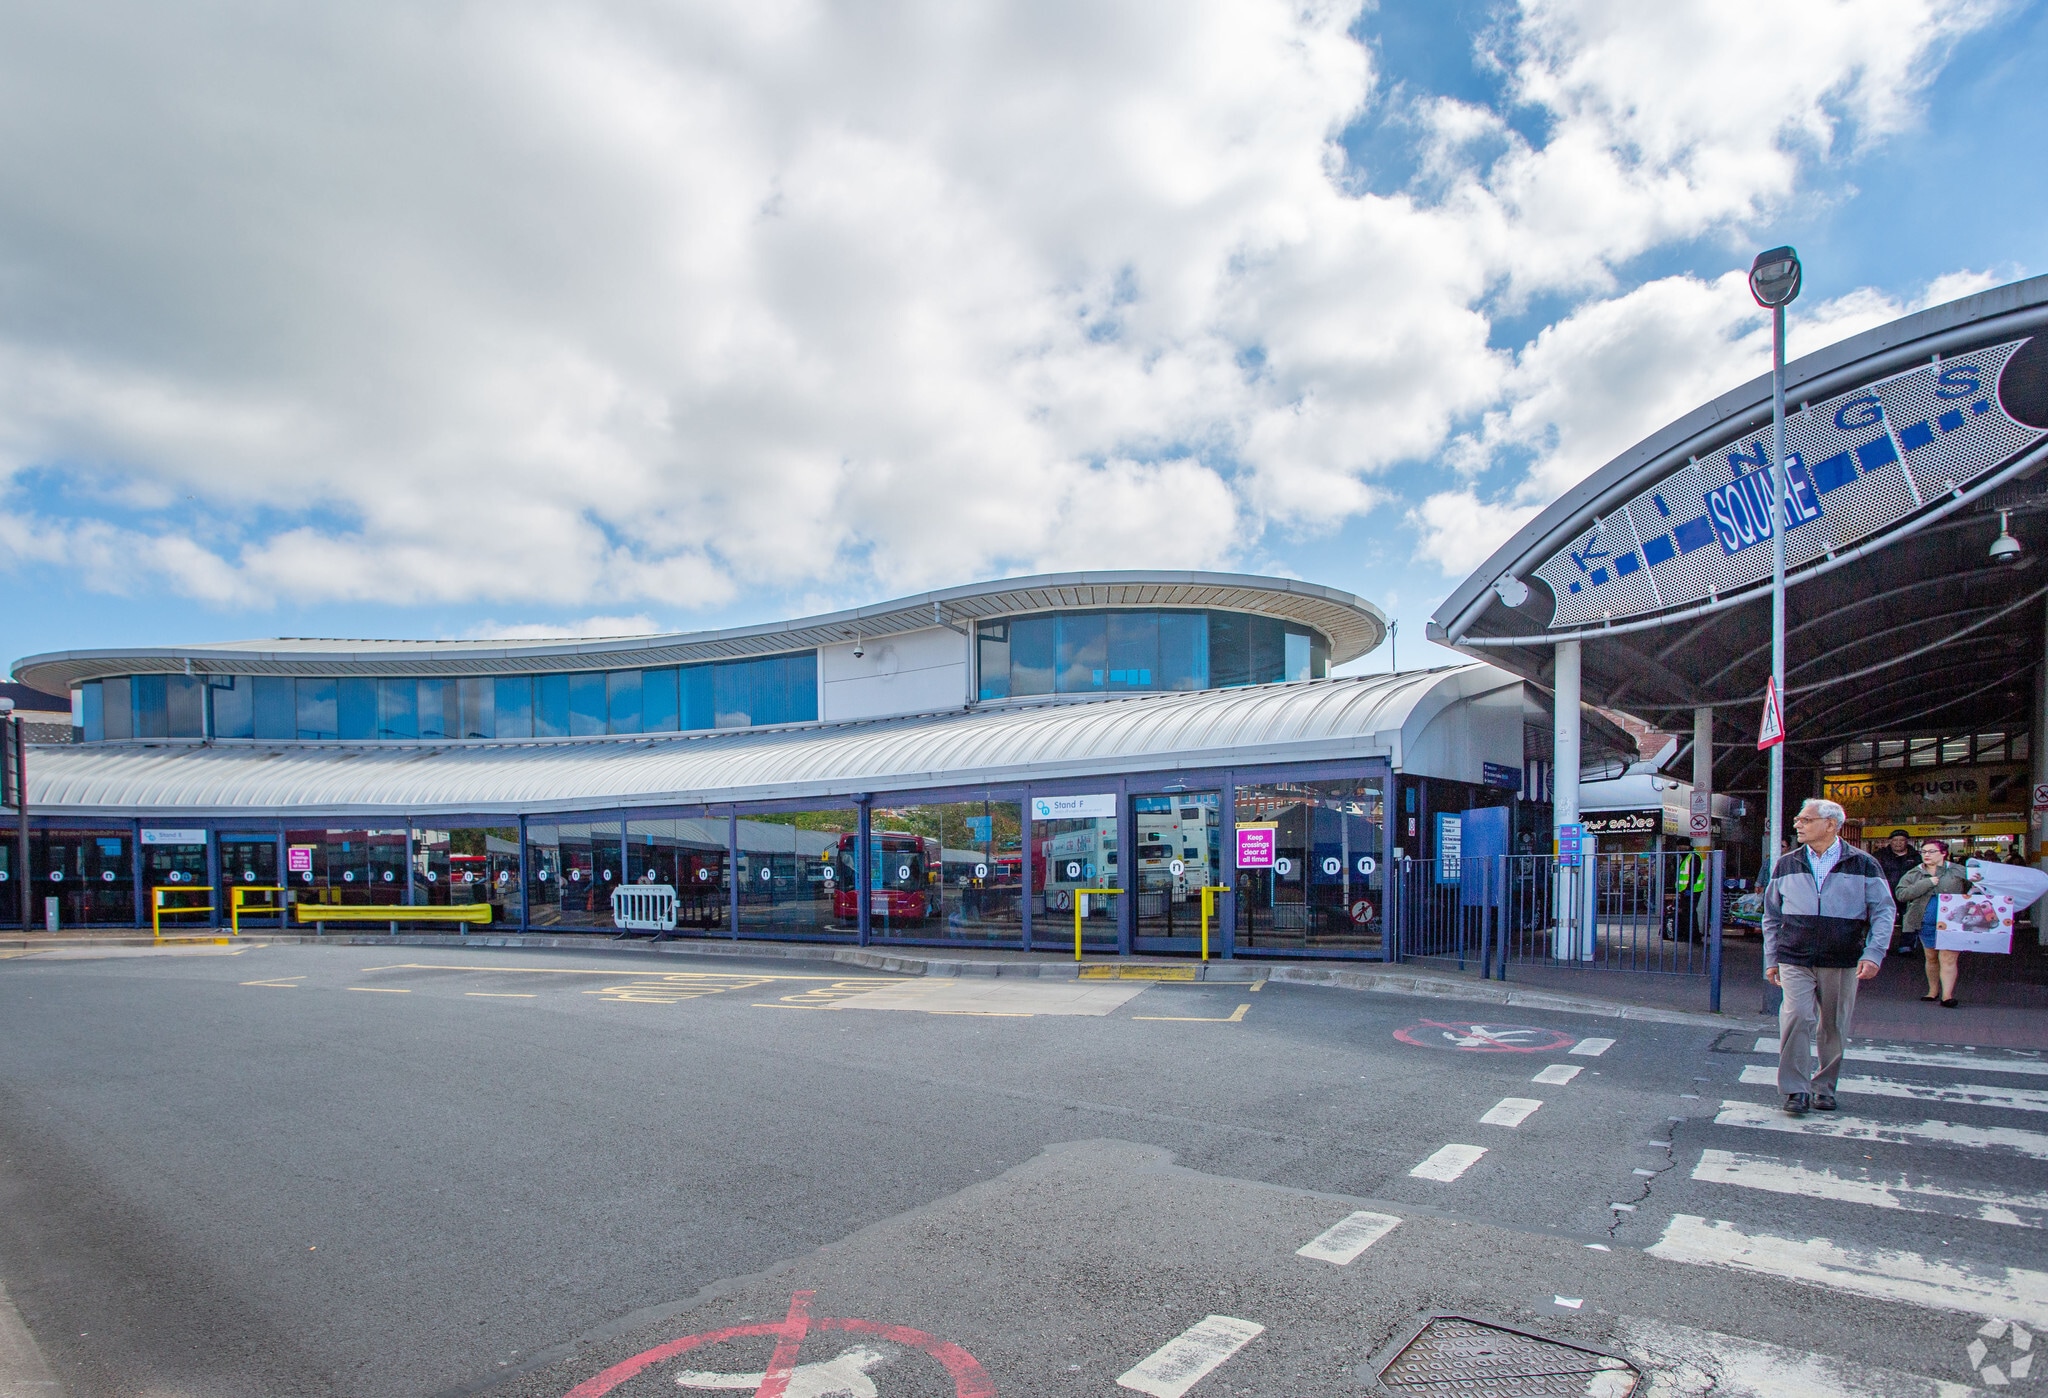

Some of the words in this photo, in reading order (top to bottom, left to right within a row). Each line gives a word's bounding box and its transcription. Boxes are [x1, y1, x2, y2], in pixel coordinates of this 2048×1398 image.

[1570, 365, 1980, 572] KINGS
[1710, 456, 1817, 551] SQUARE
[1830, 782, 1888, 798] Kings
[1895, 780, 1977, 797] Square
[1054, 800, 1076, 809] Stand
[1278, 861, 1288, 871] n
[1327, 861, 1336, 871] n
[1362, 861, 1372, 870] n
[582, 975, 775, 1002] STOP
